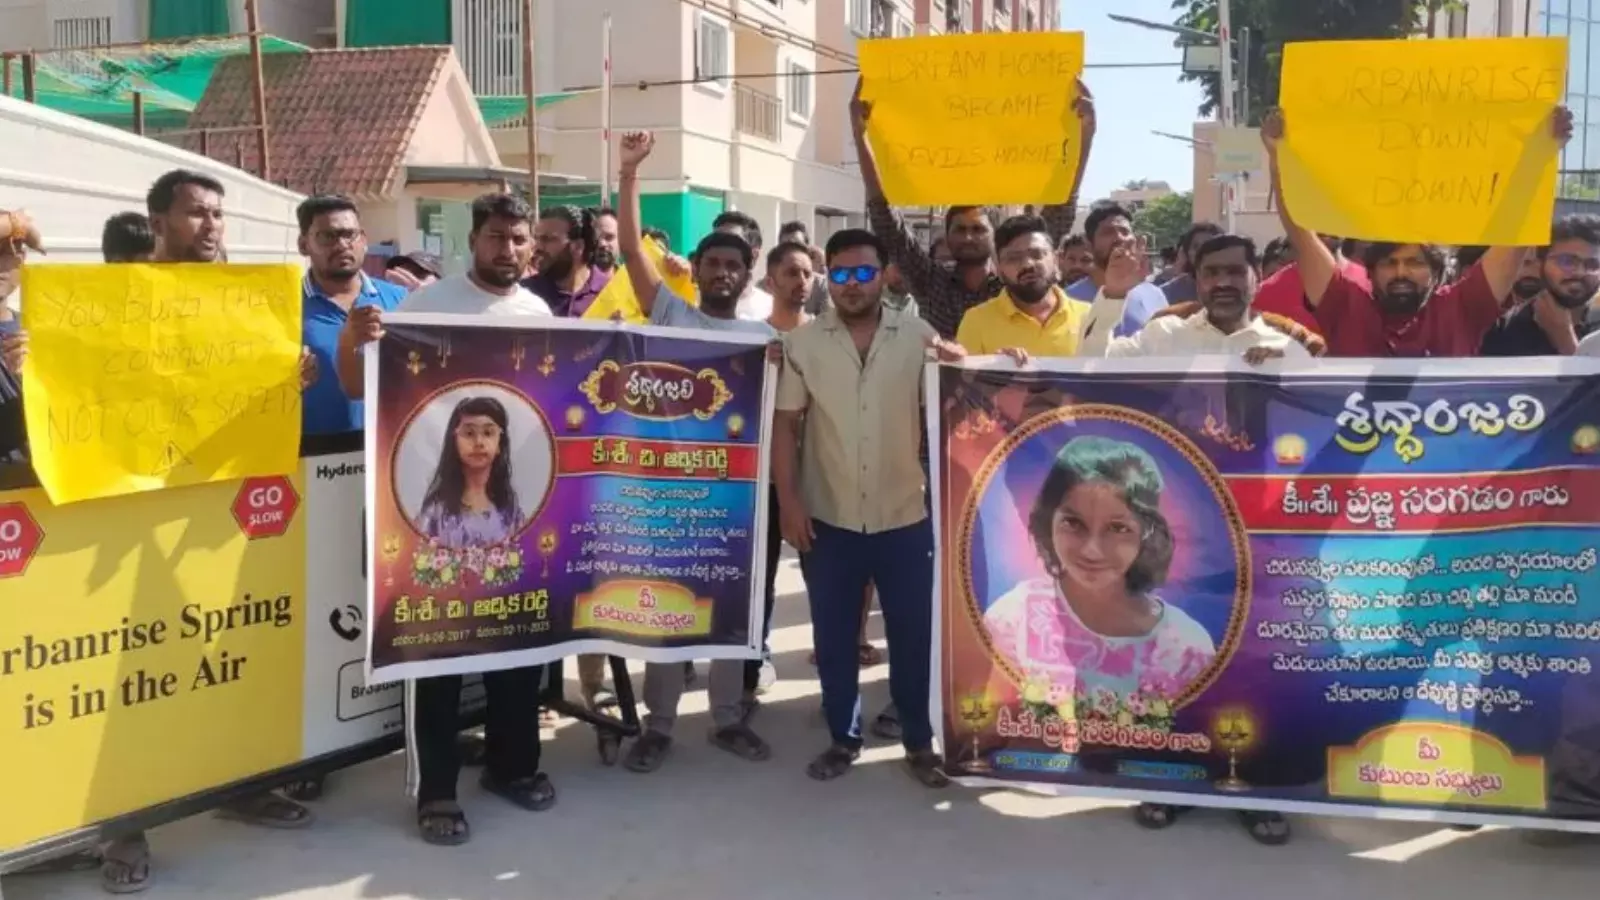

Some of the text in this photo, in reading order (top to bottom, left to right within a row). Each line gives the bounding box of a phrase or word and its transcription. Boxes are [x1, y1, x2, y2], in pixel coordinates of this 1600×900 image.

[888, 50, 1074, 84] DREAM HOME
[1318, 65, 1561, 107] URBANRISE
[943, 91, 1050, 120] BECAME
[1378, 116, 1490, 152] DOWN
[1372, 172, 1500, 207] DOWN!
[623, 369, 694, 412] శ్రద్ధాంజలి
[47, 399, 115, 450] NOT
[1335, 391, 1546, 463] శ్రద్ధాంజలి
[249, 486, 283, 508] GO
[1346, 487, 1395, 528] ప్రజ్ఞ
[1399, 487, 1514, 515] సరగడం
[1519, 485, 1568, 509] గారు
[0, 519, 22, 543] O
[249, 510, 283, 526] SLOW
[1451, 554, 1492, 573] అందరి
[638, 587, 656, 609] మీ
[1420, 590, 1441, 608] మా
[1503, 587, 1529, 603] మా
[593, 604, 646, 623] కుటుంబ
[1, 592, 292, 676] rbanrise Spring
[1525, 620, 1550, 639] మా
[1433, 648, 1453, 669] మీ
[1546, 656, 1592, 674] శాంతి
[23, 653, 247, 729] is in the Air
[1417, 736, 1441, 760] మీ
[1358, 764, 1430, 786] కుటుంబ
